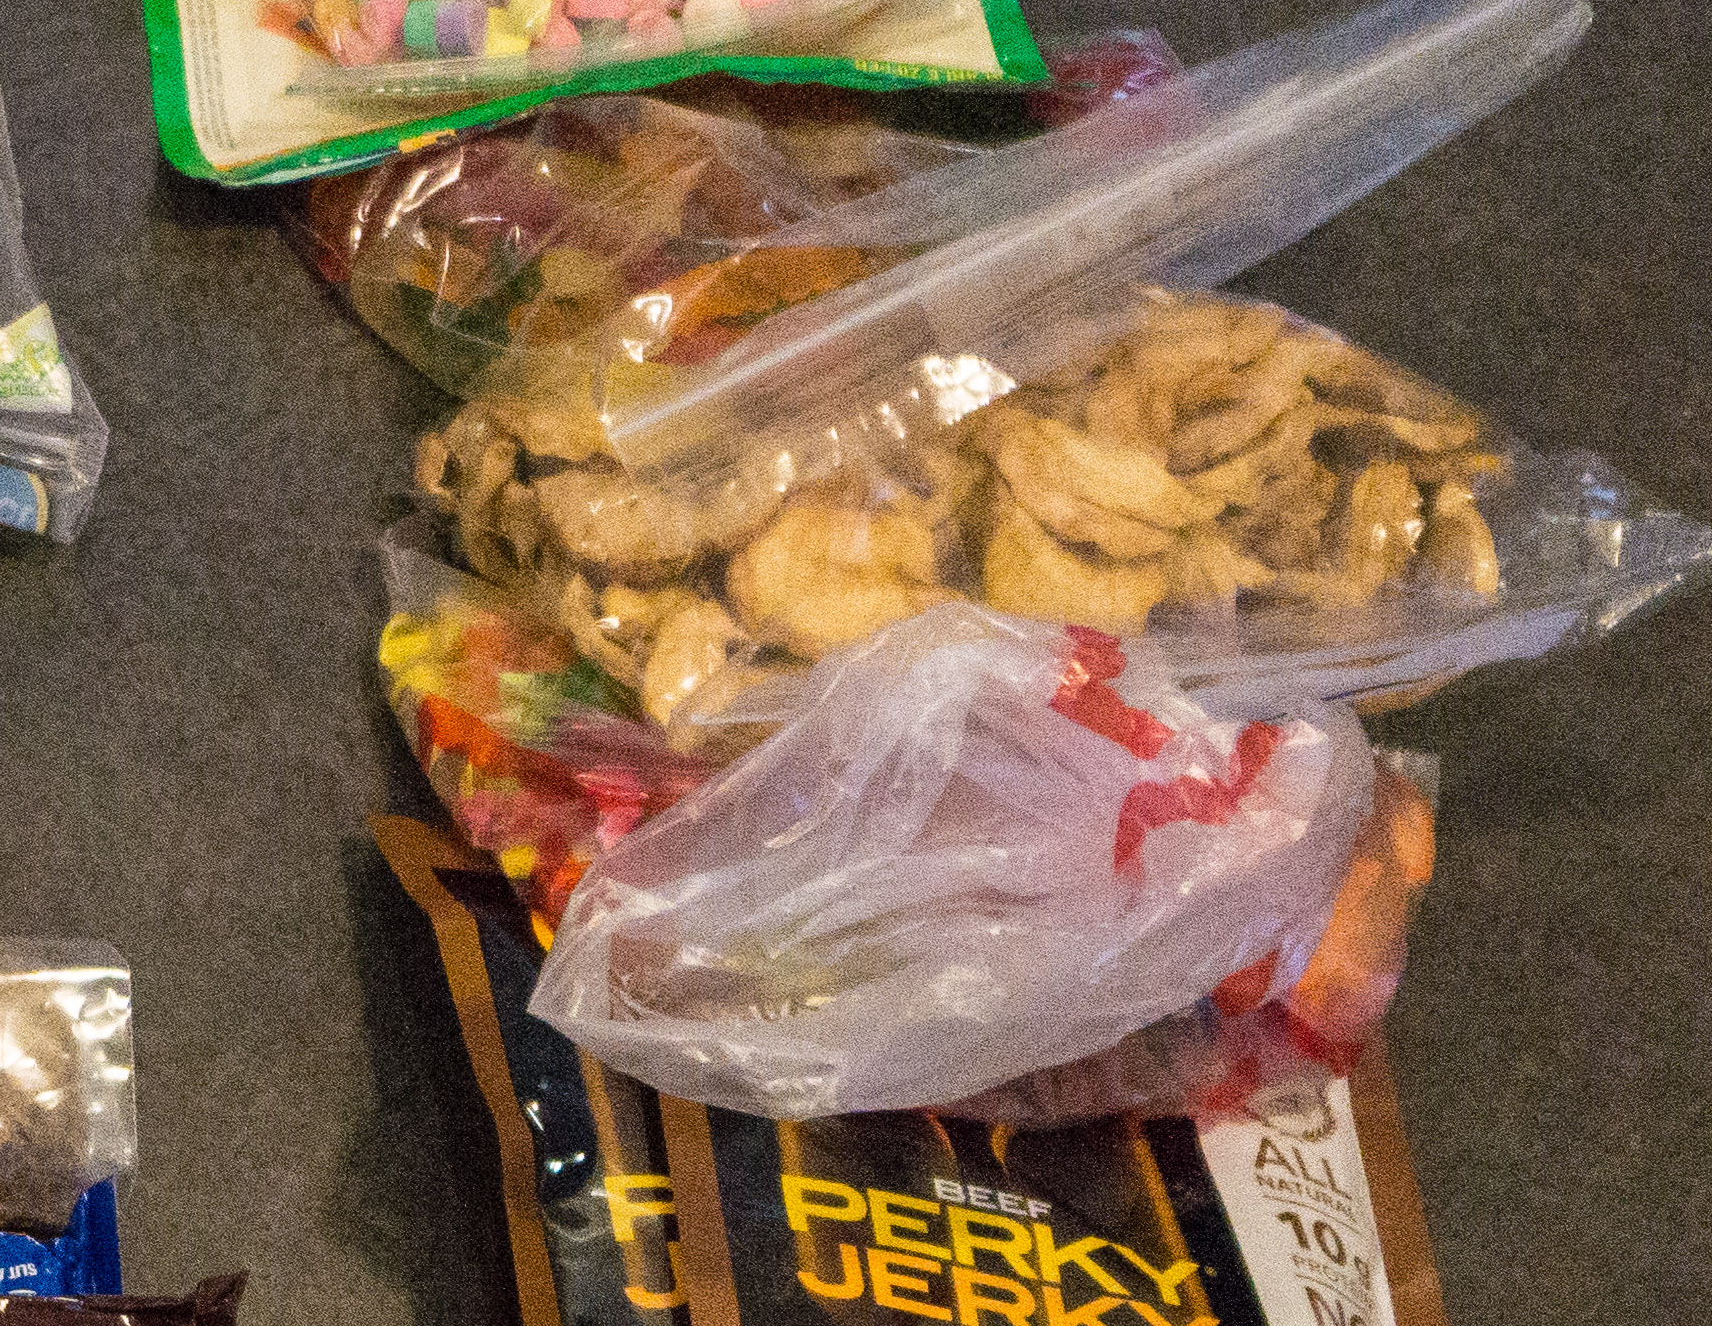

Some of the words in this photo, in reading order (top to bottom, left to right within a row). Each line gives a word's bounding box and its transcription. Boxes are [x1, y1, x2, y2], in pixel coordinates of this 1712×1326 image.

[1252, 1138, 1356, 1204] ALL
[932, 1176, 1054, 1223] BEEF
[780, 1173, 1209, 1308] PERKY
[4, 1261, 39, 1279] SLIT
